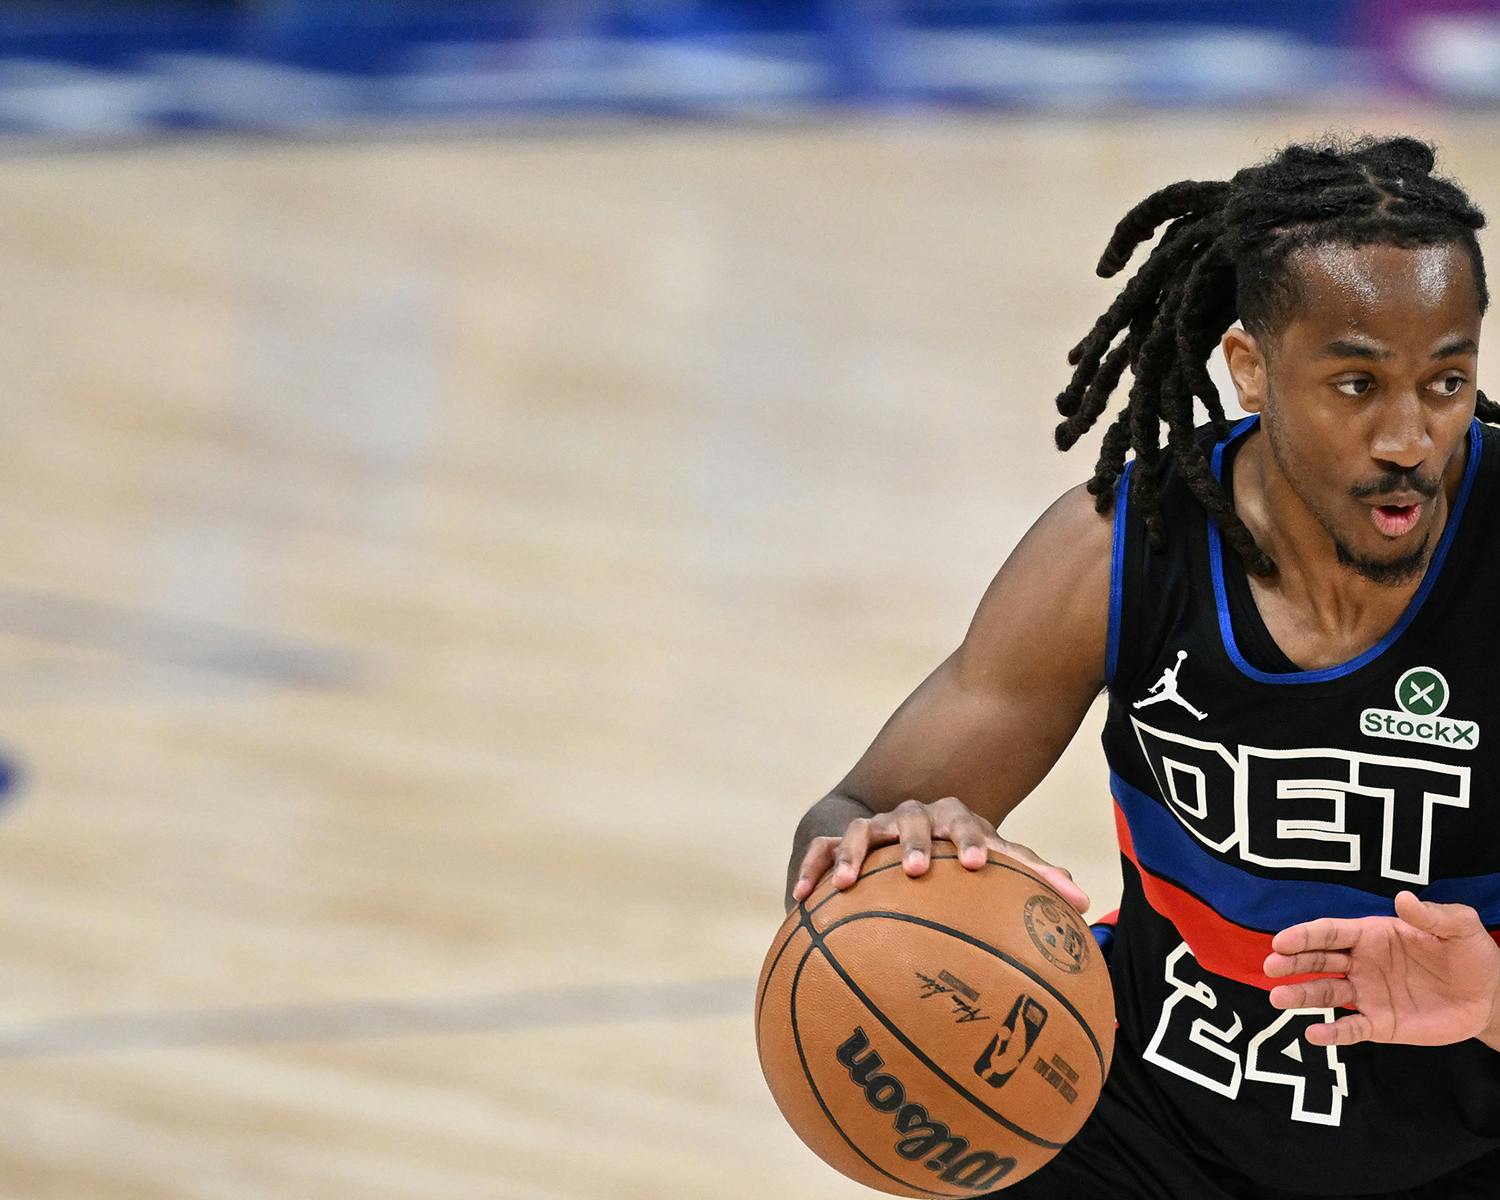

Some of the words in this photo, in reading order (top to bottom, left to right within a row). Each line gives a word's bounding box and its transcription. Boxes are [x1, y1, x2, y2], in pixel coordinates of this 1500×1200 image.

[1130, 715, 1471, 886] DET
[1364, 712, 1474, 746] StockX
[836, 1026, 1018, 1191] Wilson
[1143, 942, 1349, 1127] 24
